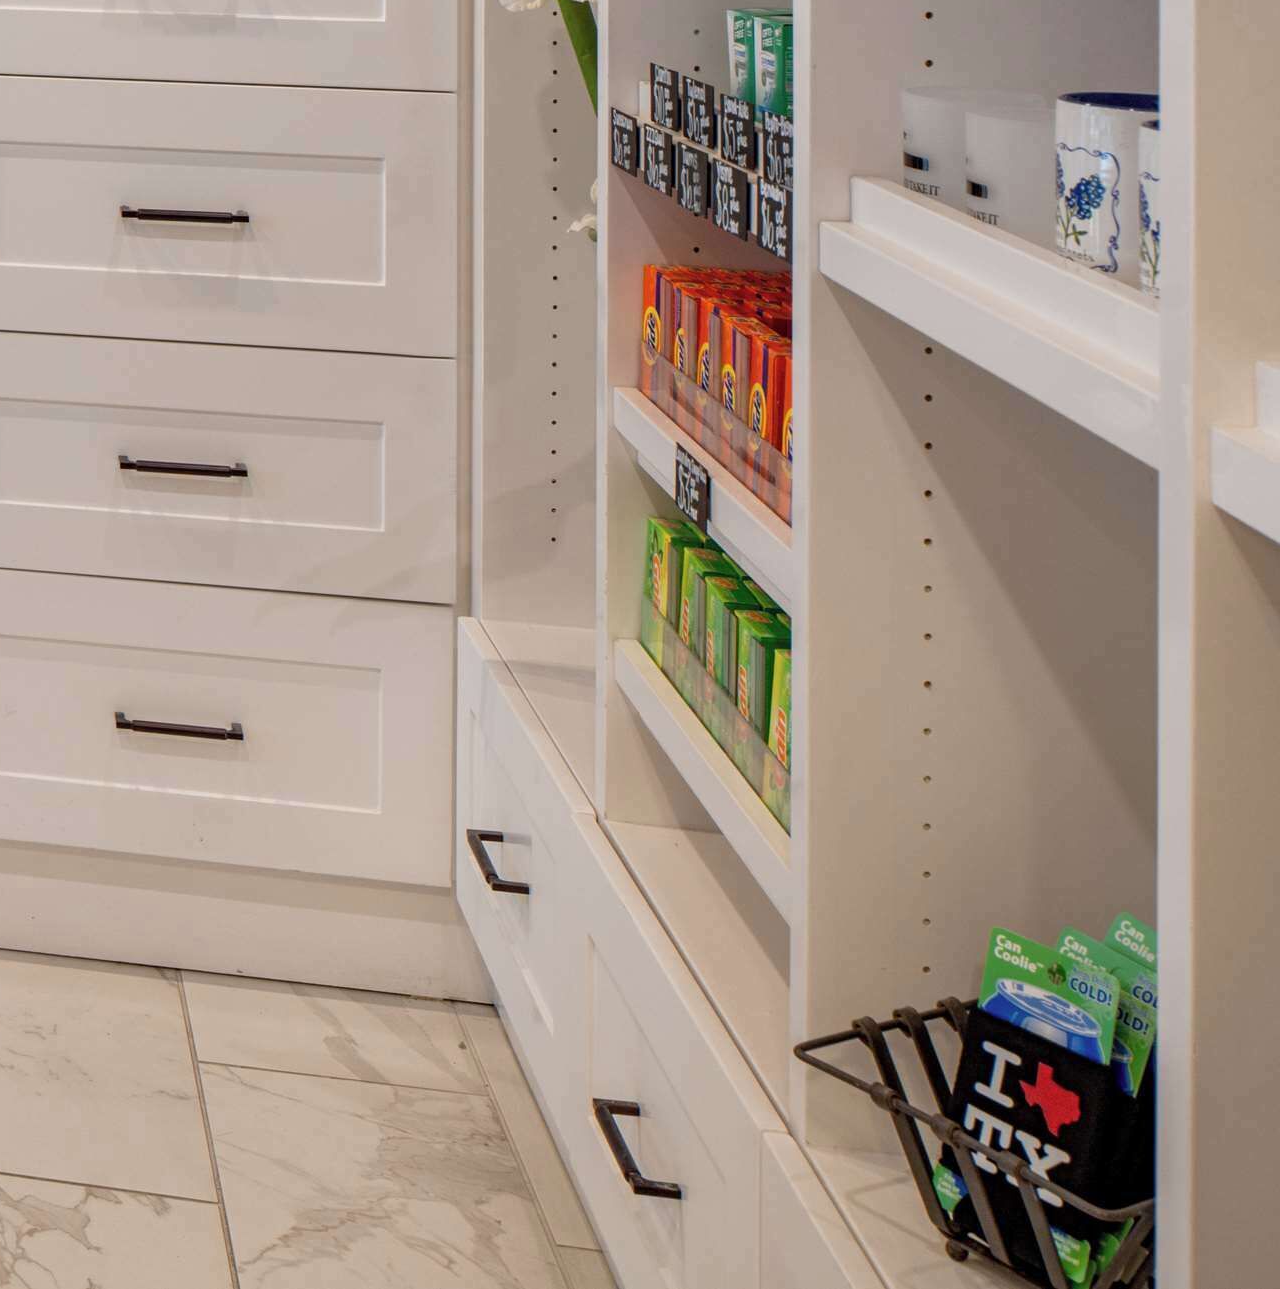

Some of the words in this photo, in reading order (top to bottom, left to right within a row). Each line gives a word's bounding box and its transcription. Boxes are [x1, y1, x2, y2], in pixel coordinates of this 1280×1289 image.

[926, 184, 941, 197] IT
[1120, 920, 1145, 942] Can
[996, 934, 1022, 954] Can
[1064, 935, 1089, 956] Can
[1114, 930, 1156, 963] Coolie
[1070, 977, 1113, 1006] COLD!
[974, 1040, 1023, 1108] I
[964, 1103, 1072, 1208] TX
